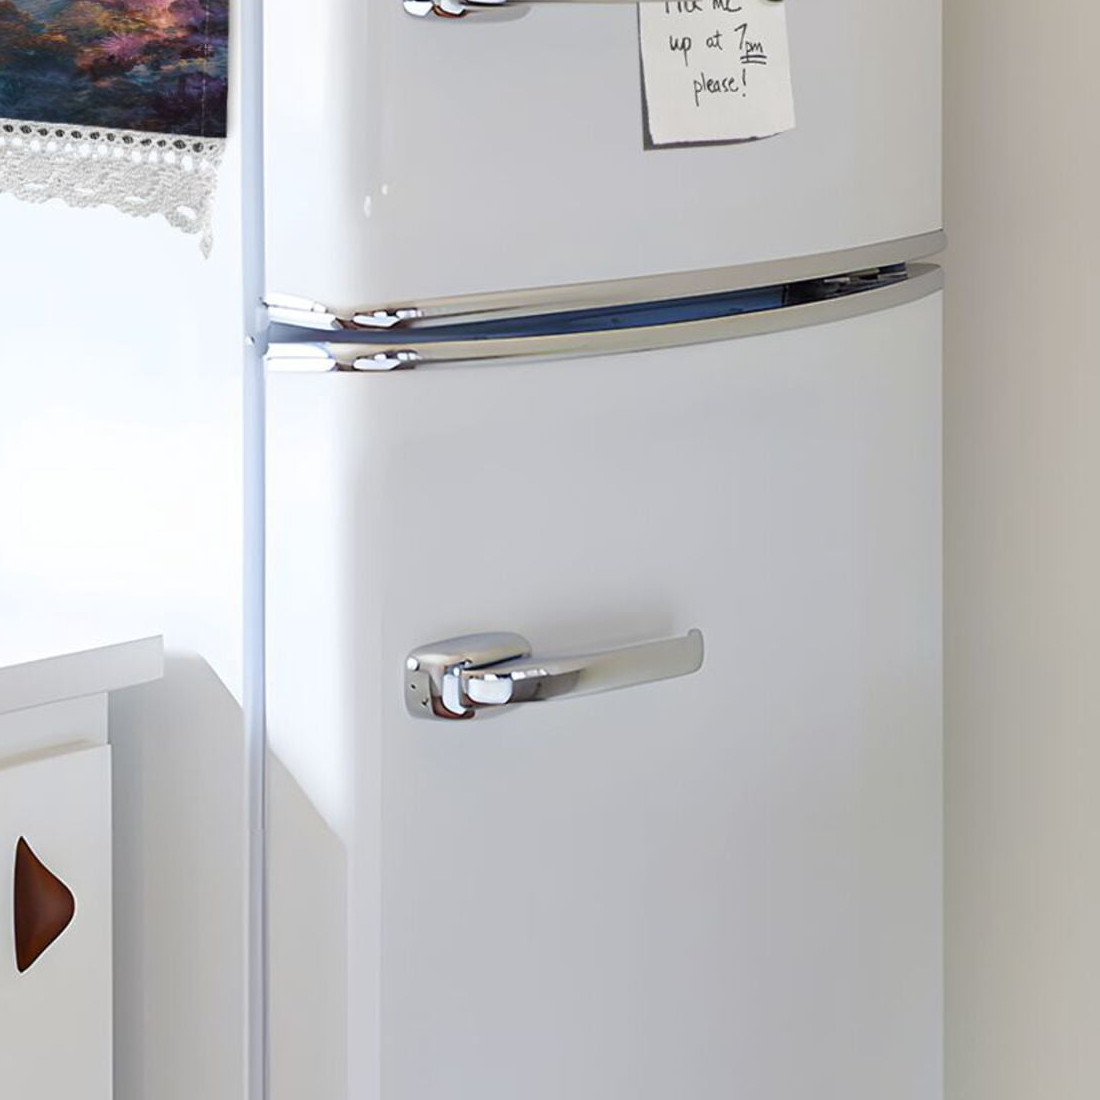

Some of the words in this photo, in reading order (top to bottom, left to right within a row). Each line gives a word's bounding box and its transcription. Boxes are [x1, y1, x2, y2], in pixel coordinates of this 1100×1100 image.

[669, 35, 691, 67] up
[706, 30, 723, 51] at
[693, 68, 748, 107] please!
